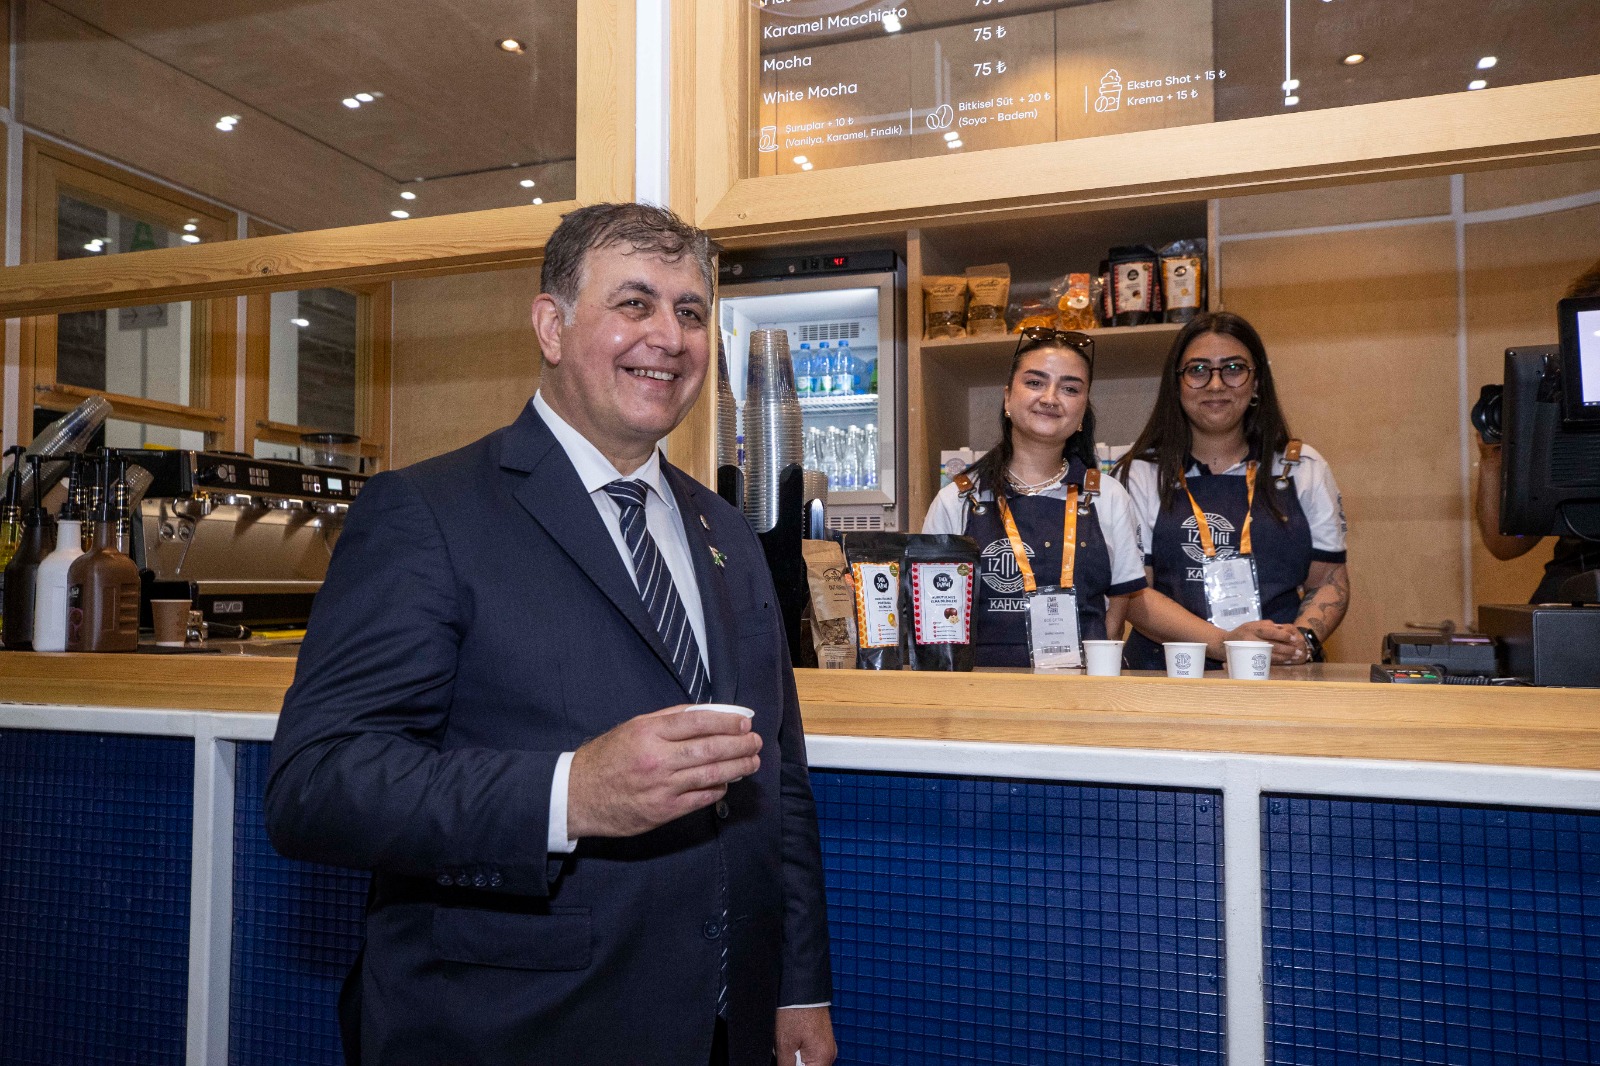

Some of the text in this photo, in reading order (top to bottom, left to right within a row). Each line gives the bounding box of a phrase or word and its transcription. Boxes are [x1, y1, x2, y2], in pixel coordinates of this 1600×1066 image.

[764, 17, 823, 39] Karamel
[973, 25, 1007, 42] 75 ₺
[763, 55, 812, 72] Mocha
[973, 60, 1007, 77] 75 ₺
[1127, 78, 1162, 91] Ekstra
[1165, 74, 1192, 86] Shot
[1204, 70, 1216, 80] 15
[763, 82, 858, 105] White Mocha
[958, 98, 994, 112] Bitkisel
[996, 96, 1014, 107] Süt
[1028, 92, 1042, 103] 20
[1127, 95, 1164, 106] Krema
[1166, 93, 1173, 101] +
[1176, 90, 1188, 100] 15
[785, 120, 825, 134] Şuruplar
[835, 117, 846, 127] 10
[958, 115, 987, 128] (Soya
[997, 108, 1038, 122] Badem)
[870, 124, 903, 137] Fındık)
